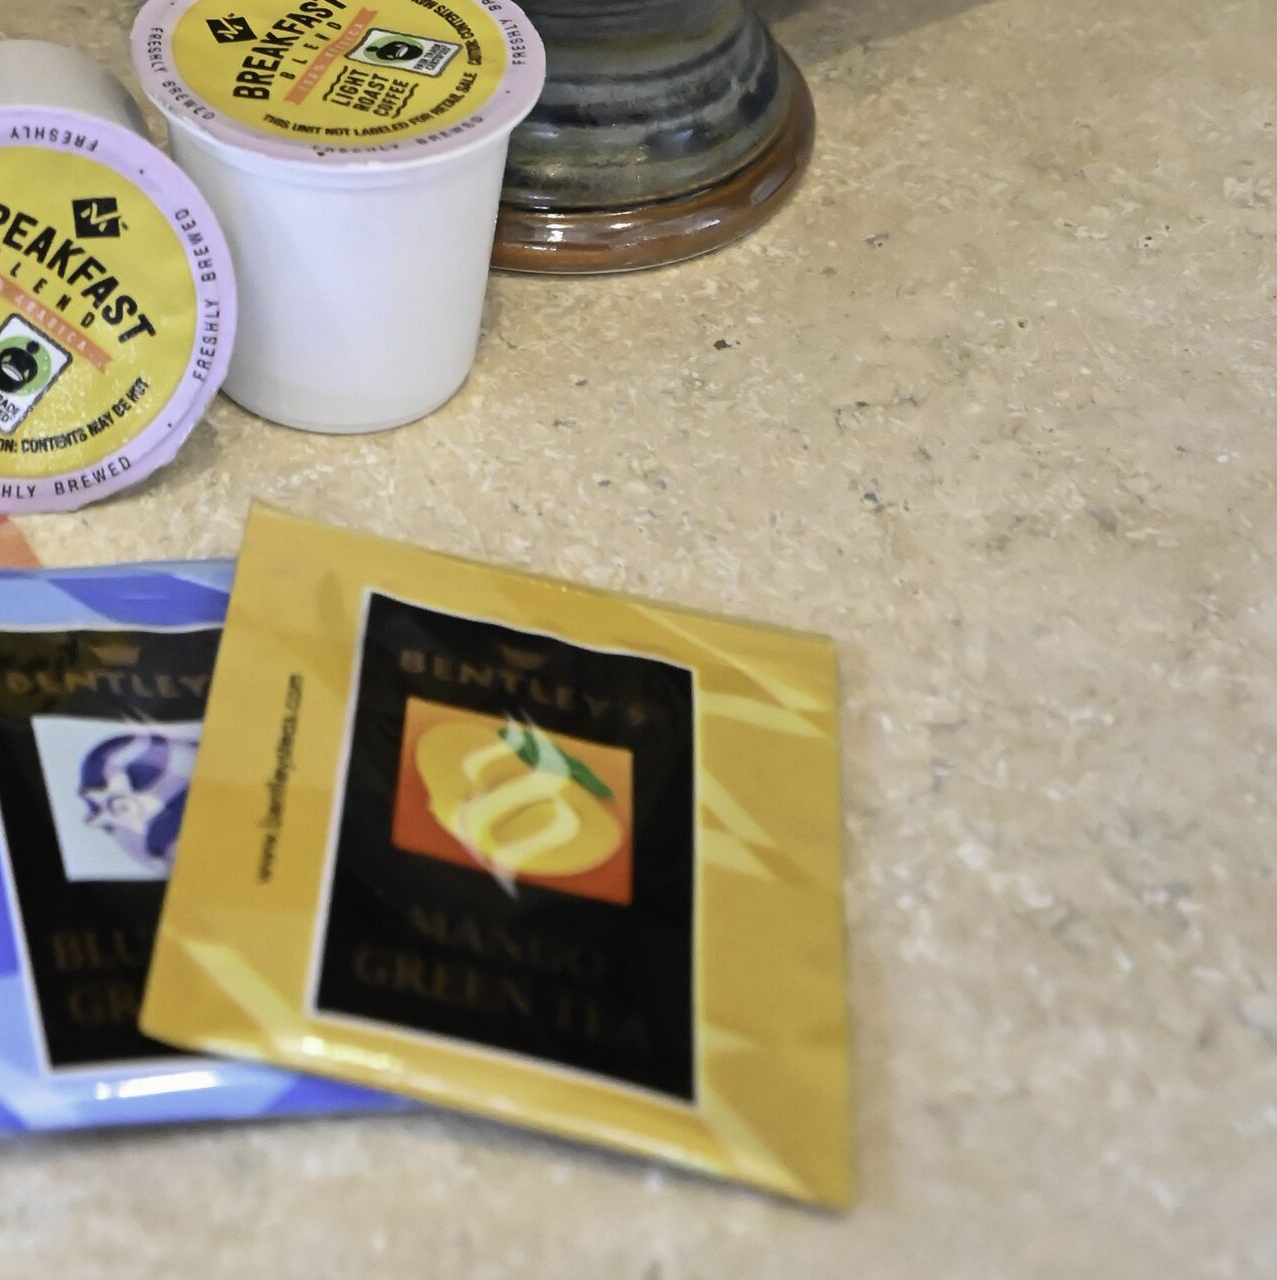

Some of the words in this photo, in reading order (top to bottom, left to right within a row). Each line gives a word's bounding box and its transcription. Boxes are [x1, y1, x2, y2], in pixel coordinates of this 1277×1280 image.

[499, 17, 527, 66] FRESHLY
[147, 27, 168, 73] FRESHLY
[162, 80, 216, 120] BREWED
[331, 68, 369, 107] LIGHT
[353, 73, 390, 112] ROAST
[292, 124, 322, 135] UNIT
[324, 127, 351, 136] NOT
[353, 122, 410, 137] LABELED
[409, 112, 433, 125] FOR
[430, 91, 463, 118] RETAIL
[455, 72, 478, 97] SALE
[373, 78, 410, 117] COFFEE
[11, 127, 98, 152] FRESHLY
[175, 208, 217, 283] BREWED
[193, 299, 221, 381] FRESHLY
[89, 411, 114, 436] MAY
[54, 455, 131, 496] BREWED
